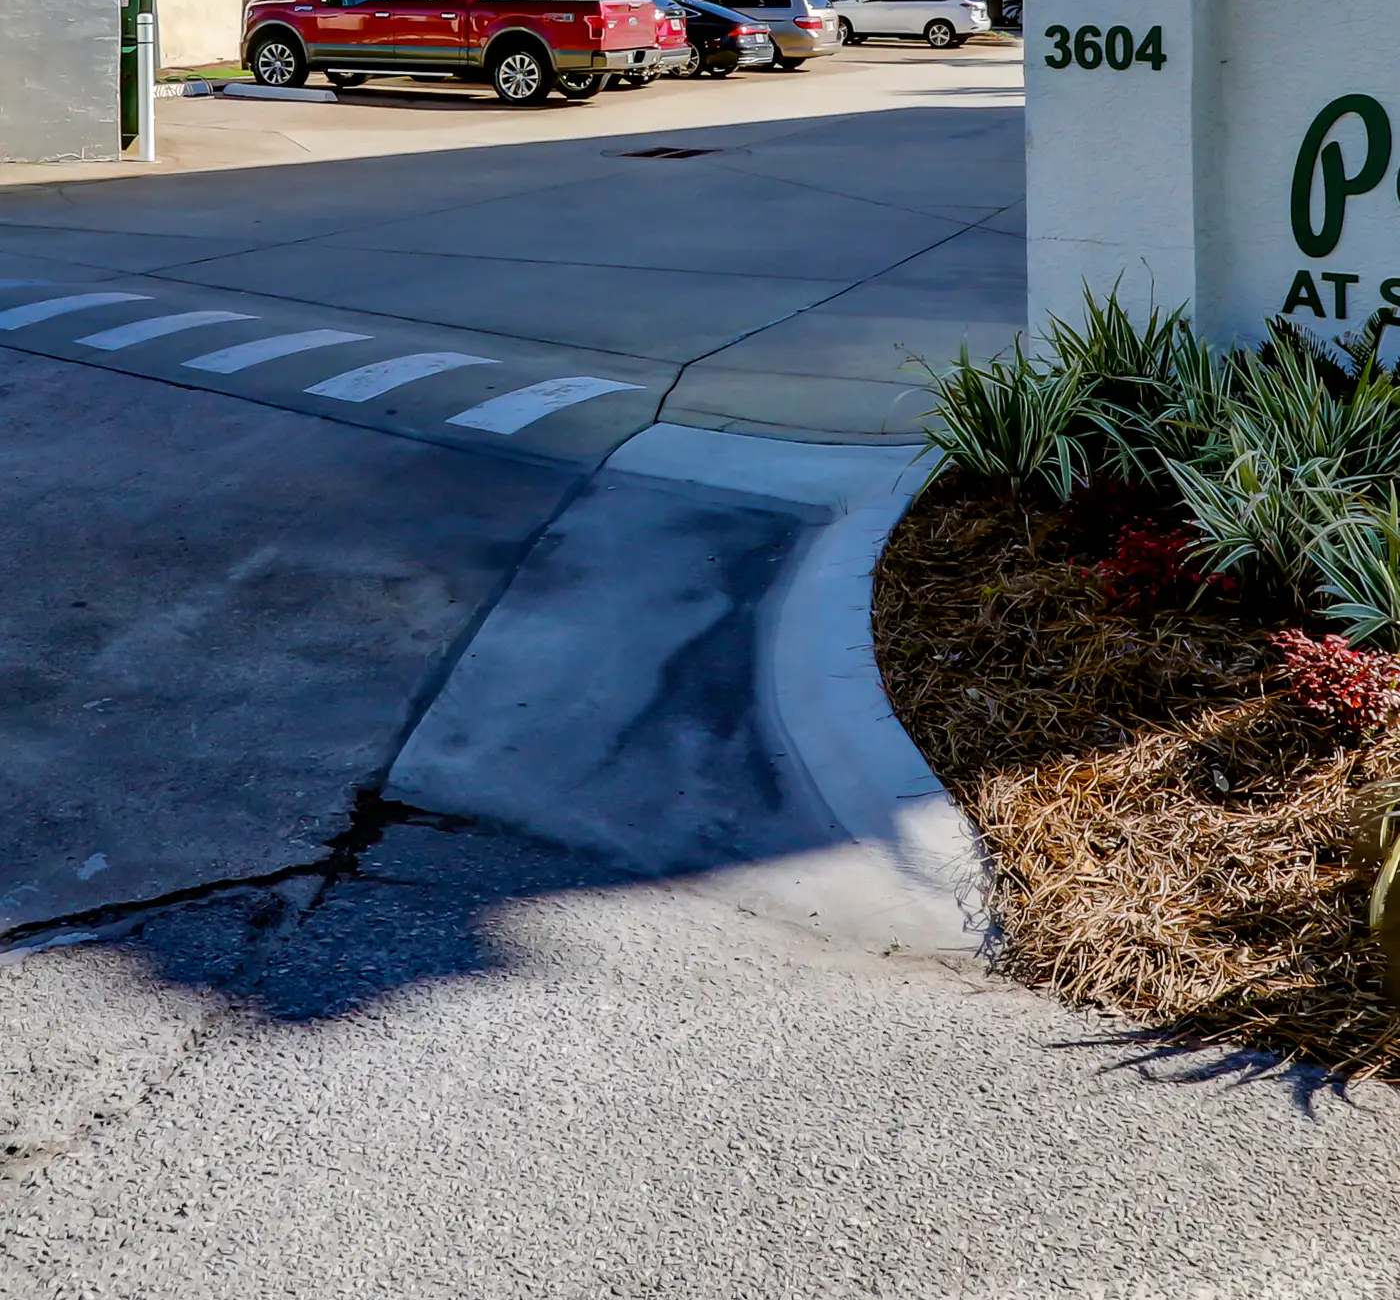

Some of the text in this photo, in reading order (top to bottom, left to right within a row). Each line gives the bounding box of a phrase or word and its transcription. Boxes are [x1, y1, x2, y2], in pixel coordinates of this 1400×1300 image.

[1043, 24, 1168, 71] 3604
[1290, 93, 1400, 258] P
[1281, 269, 1359, 320] AT
